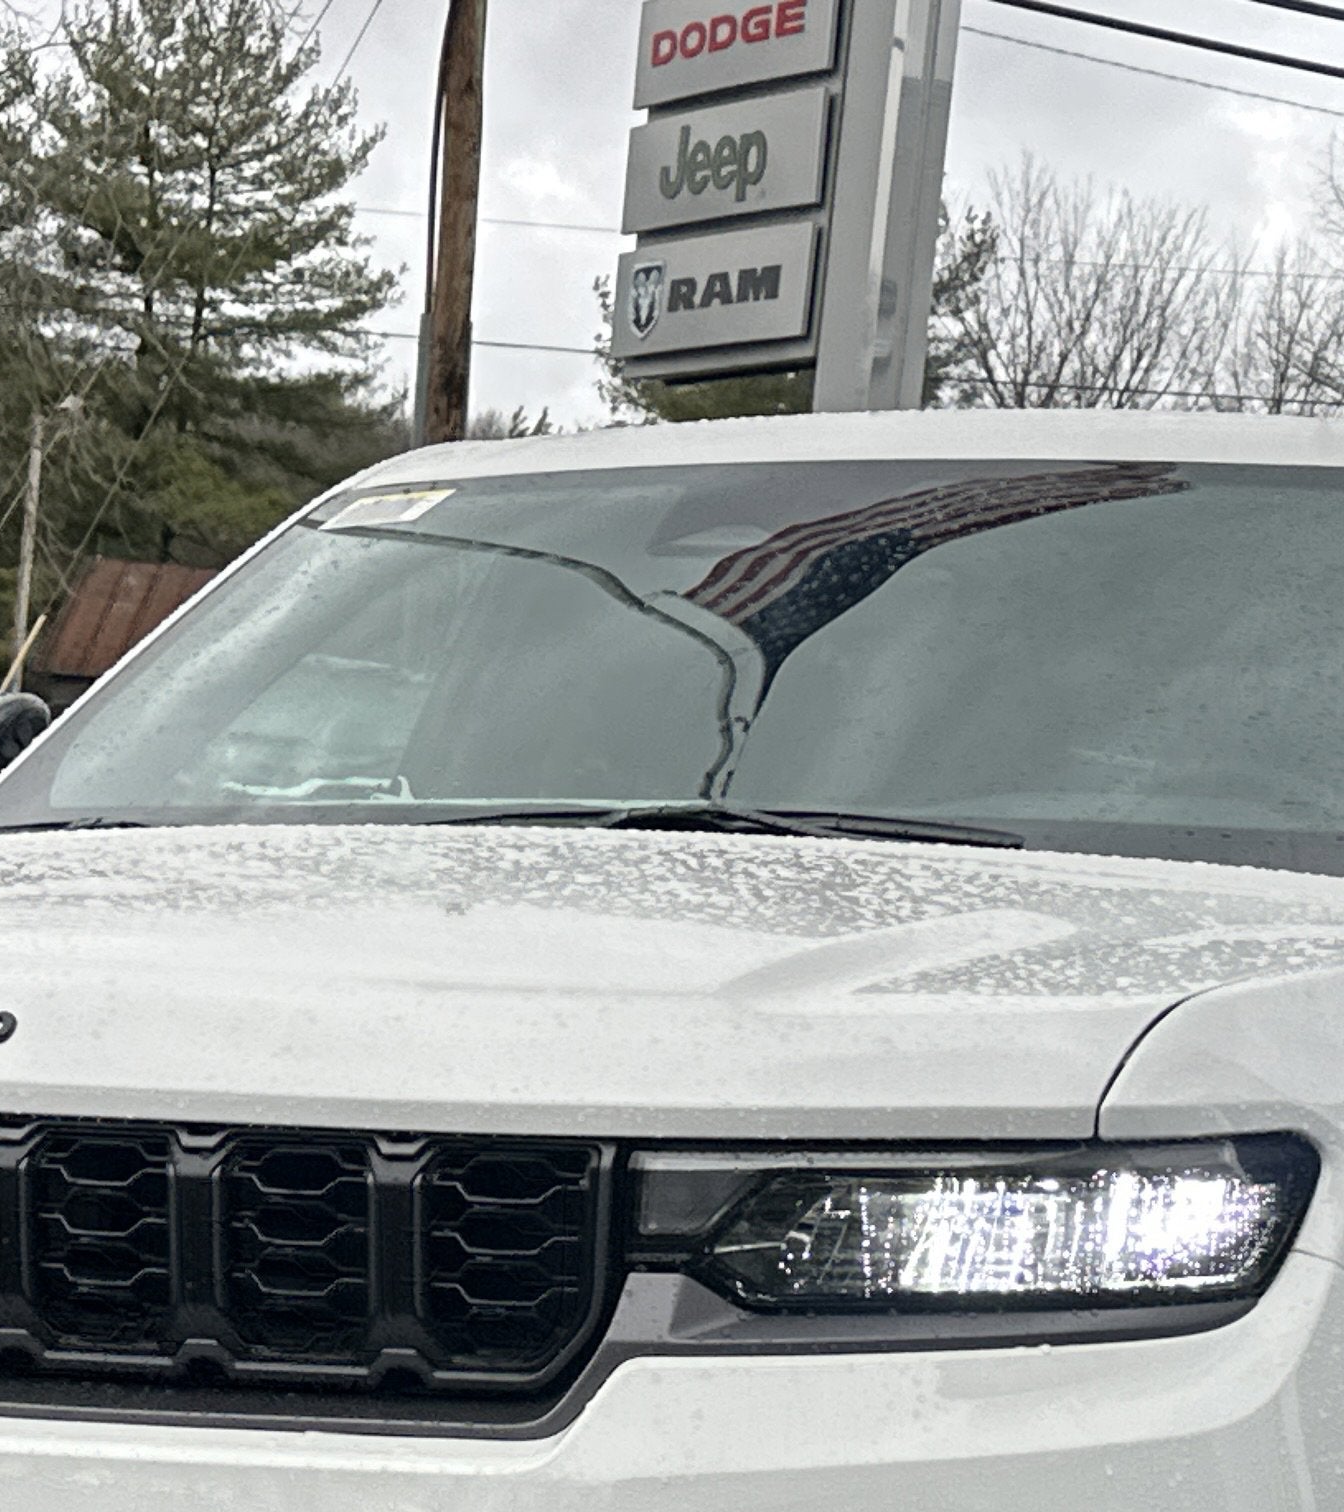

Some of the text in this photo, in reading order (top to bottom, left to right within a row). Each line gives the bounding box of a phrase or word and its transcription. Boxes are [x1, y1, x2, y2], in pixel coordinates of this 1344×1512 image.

[651, 0, 807, 68] DODGE
[659, 124, 767, 201] Jeep
[667, 264, 782, 313] RAM
